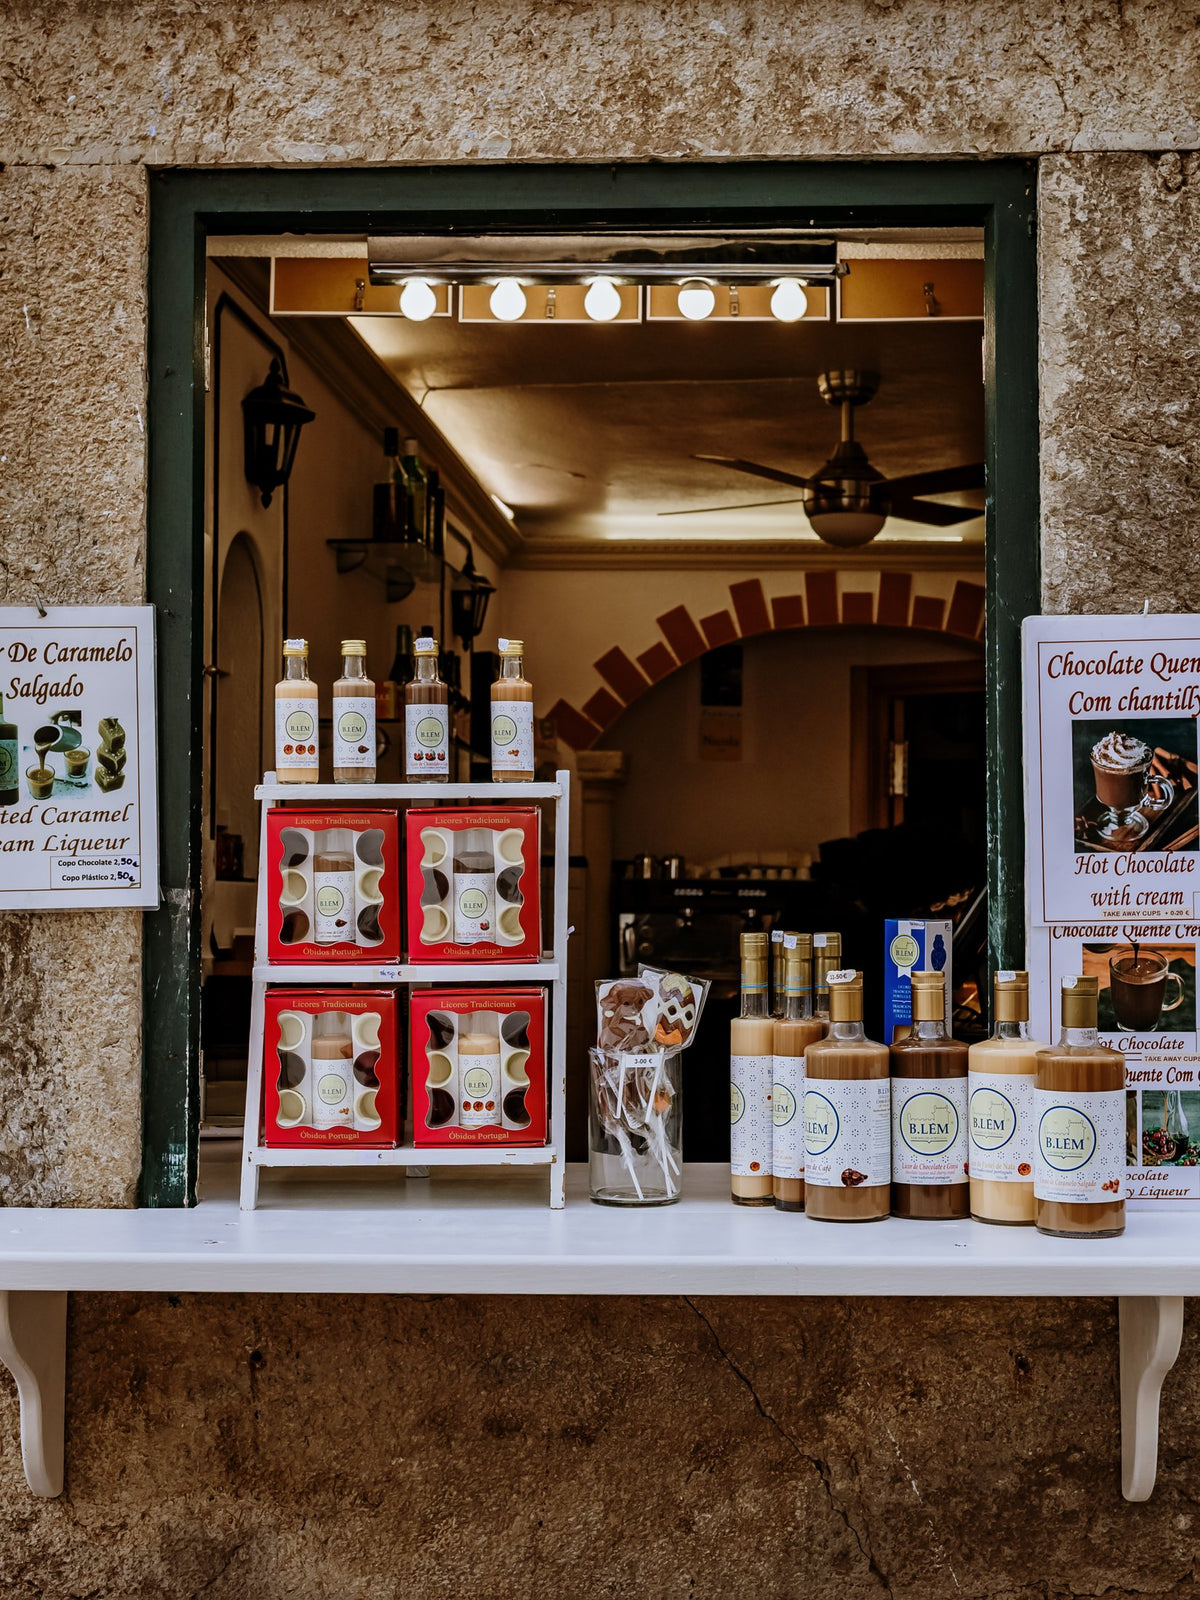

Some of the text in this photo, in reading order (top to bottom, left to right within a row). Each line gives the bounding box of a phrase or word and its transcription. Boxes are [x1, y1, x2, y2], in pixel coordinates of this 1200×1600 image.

[8, 638, 133, 665] De Caramelo
[1047, 650, 1144, 679] Chocolate
[5, 673, 84, 705] Salgado
[1068, 690, 1112, 715] Com
[40, 802, 135, 826] Caramel
[295, 817, 371, 825] Licores Tradicionais
[435, 816, 511, 825] Licores Tradicionais
[41, 833, 131, 857] Liqueur
[57, 859, 76, 867] Copo
[77, 858, 112, 866] Chocolate
[1074, 851, 1195, 876] Hot Chocolate
[61, 874, 80, 882] Copo
[81, 873, 109, 881] Plástico
[1090, 884, 1185, 907] with cream
[1175, 924, 1200, 939] Cre
[302, 947, 363, 956] Óbidos Portugal
[443, 946, 504, 956] Óbidos Portugal
[292, 1000, 368, 1008] Licores Tradicionais
[440, 1000, 516, 1009] Licores Tradicionais
[1098, 1035, 1185, 1051] ot Chocolate
[1166, 1066, 1193, 1084] Com
[300, 1130, 360, 1141] Óbidos Portugal
[448, 1131, 510, 1140] Óbidos Portugal
[1139, 1186, 1191, 1199] Liqueur
